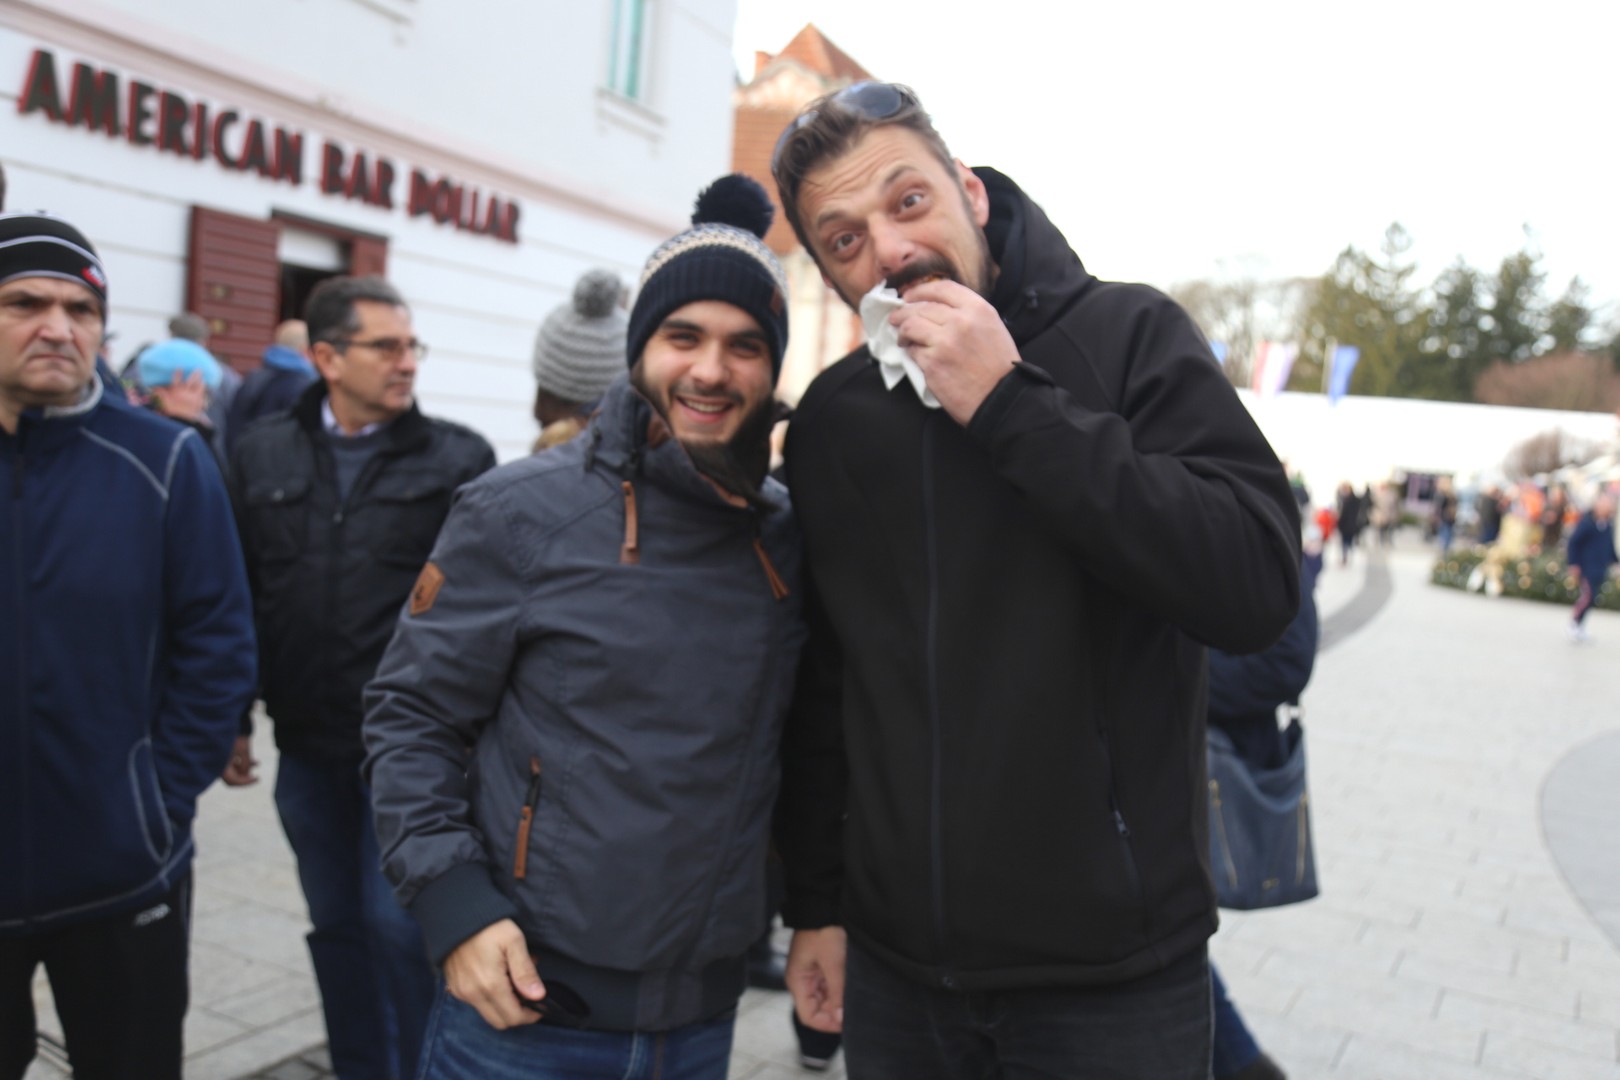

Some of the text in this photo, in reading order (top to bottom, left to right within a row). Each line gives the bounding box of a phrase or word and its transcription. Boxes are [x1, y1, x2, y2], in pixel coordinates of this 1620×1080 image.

[17, 48, 521, 244] AMERICAN BAR DOLLAR
